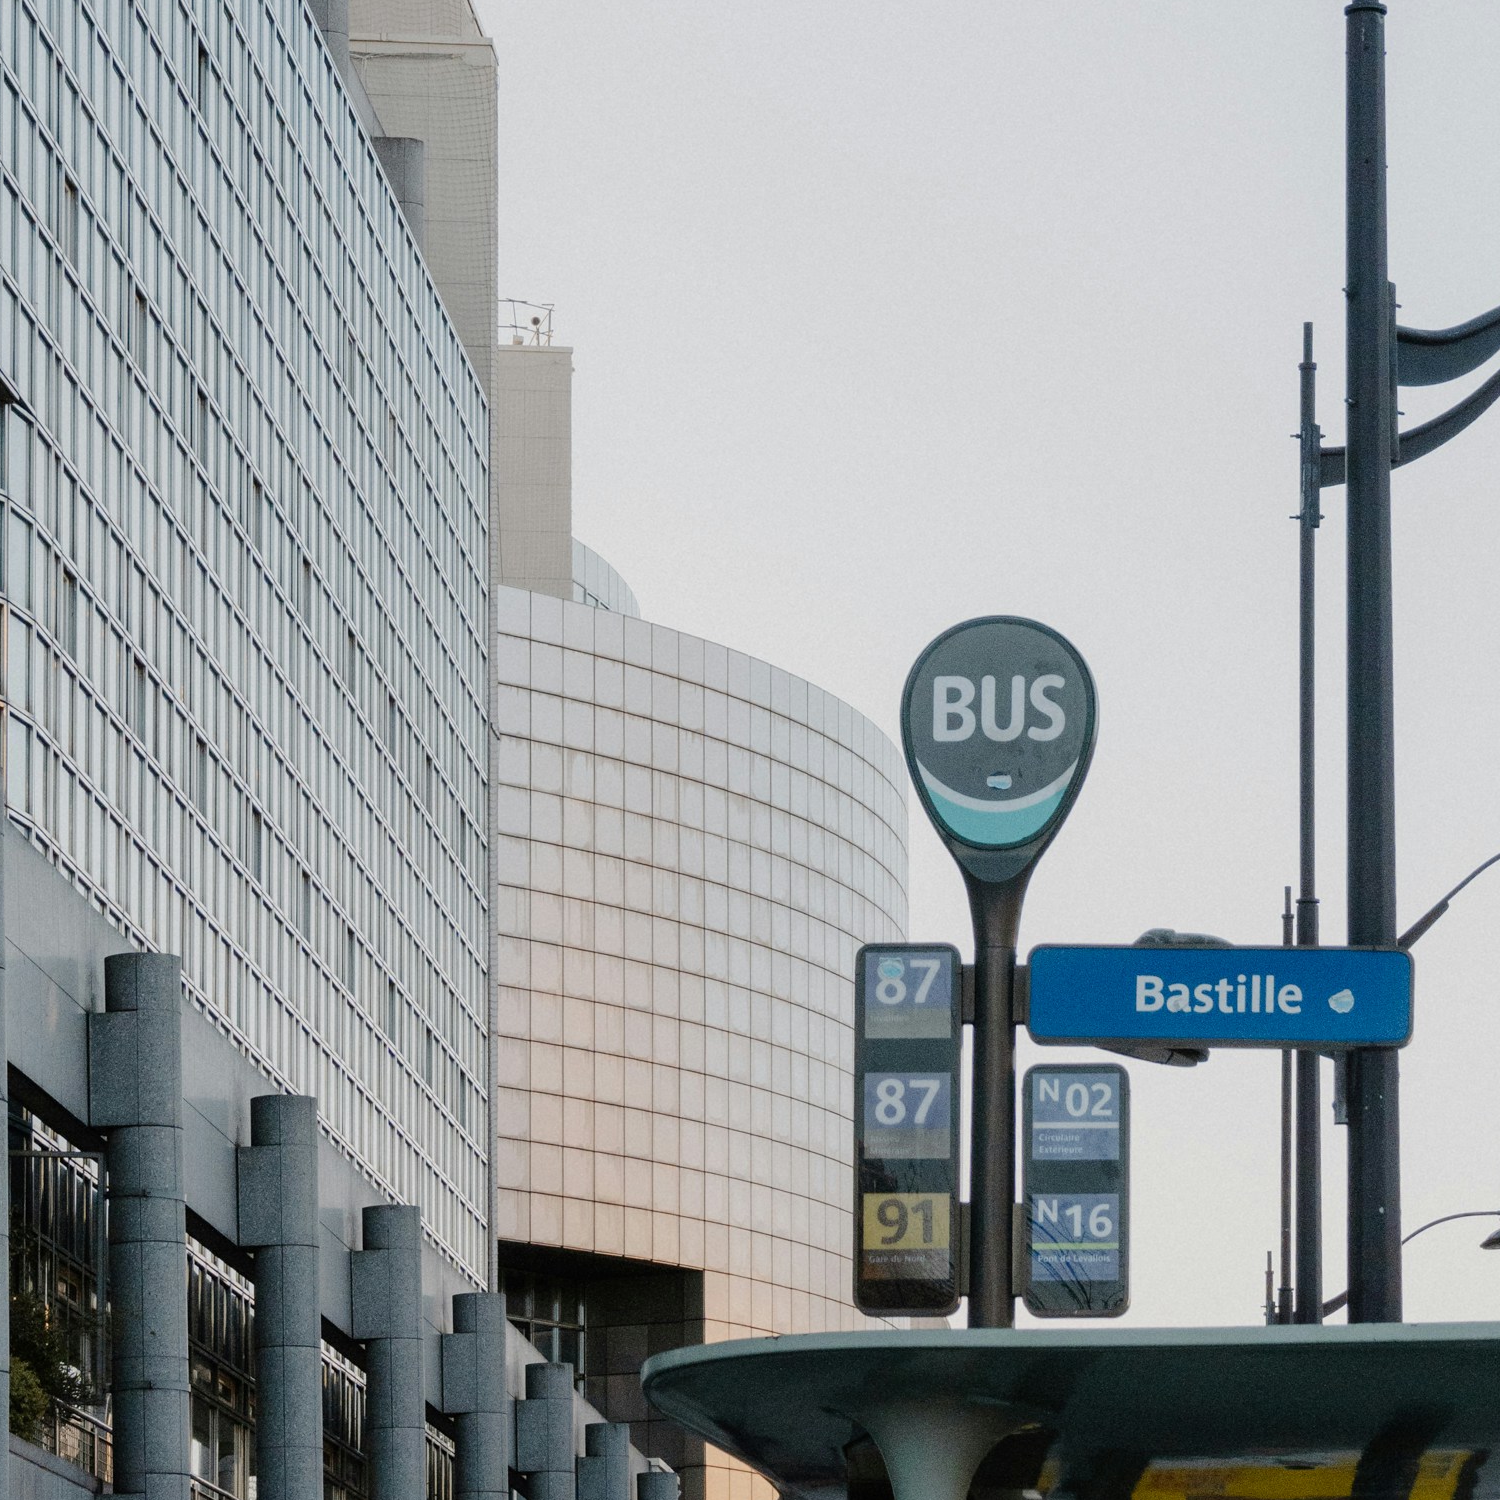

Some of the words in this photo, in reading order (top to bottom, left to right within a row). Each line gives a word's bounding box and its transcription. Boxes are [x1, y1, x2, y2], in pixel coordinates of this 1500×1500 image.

[932, 674, 1066, 742] BUS
[875, 957, 941, 1005] 87
[1135, 973, 1303, 1014] Bastille
[875, 1078, 940, 1125] 87
[877, 1198, 933, 1245] 91
[868, 1254, 889, 1263] Gare
[890, 1254, 901, 1263] du
[904, 1254, 926, 1263] Nord
[1060, 1254, 1071, 1262] de
[1073, 1253, 1111, 1263] Levallois
